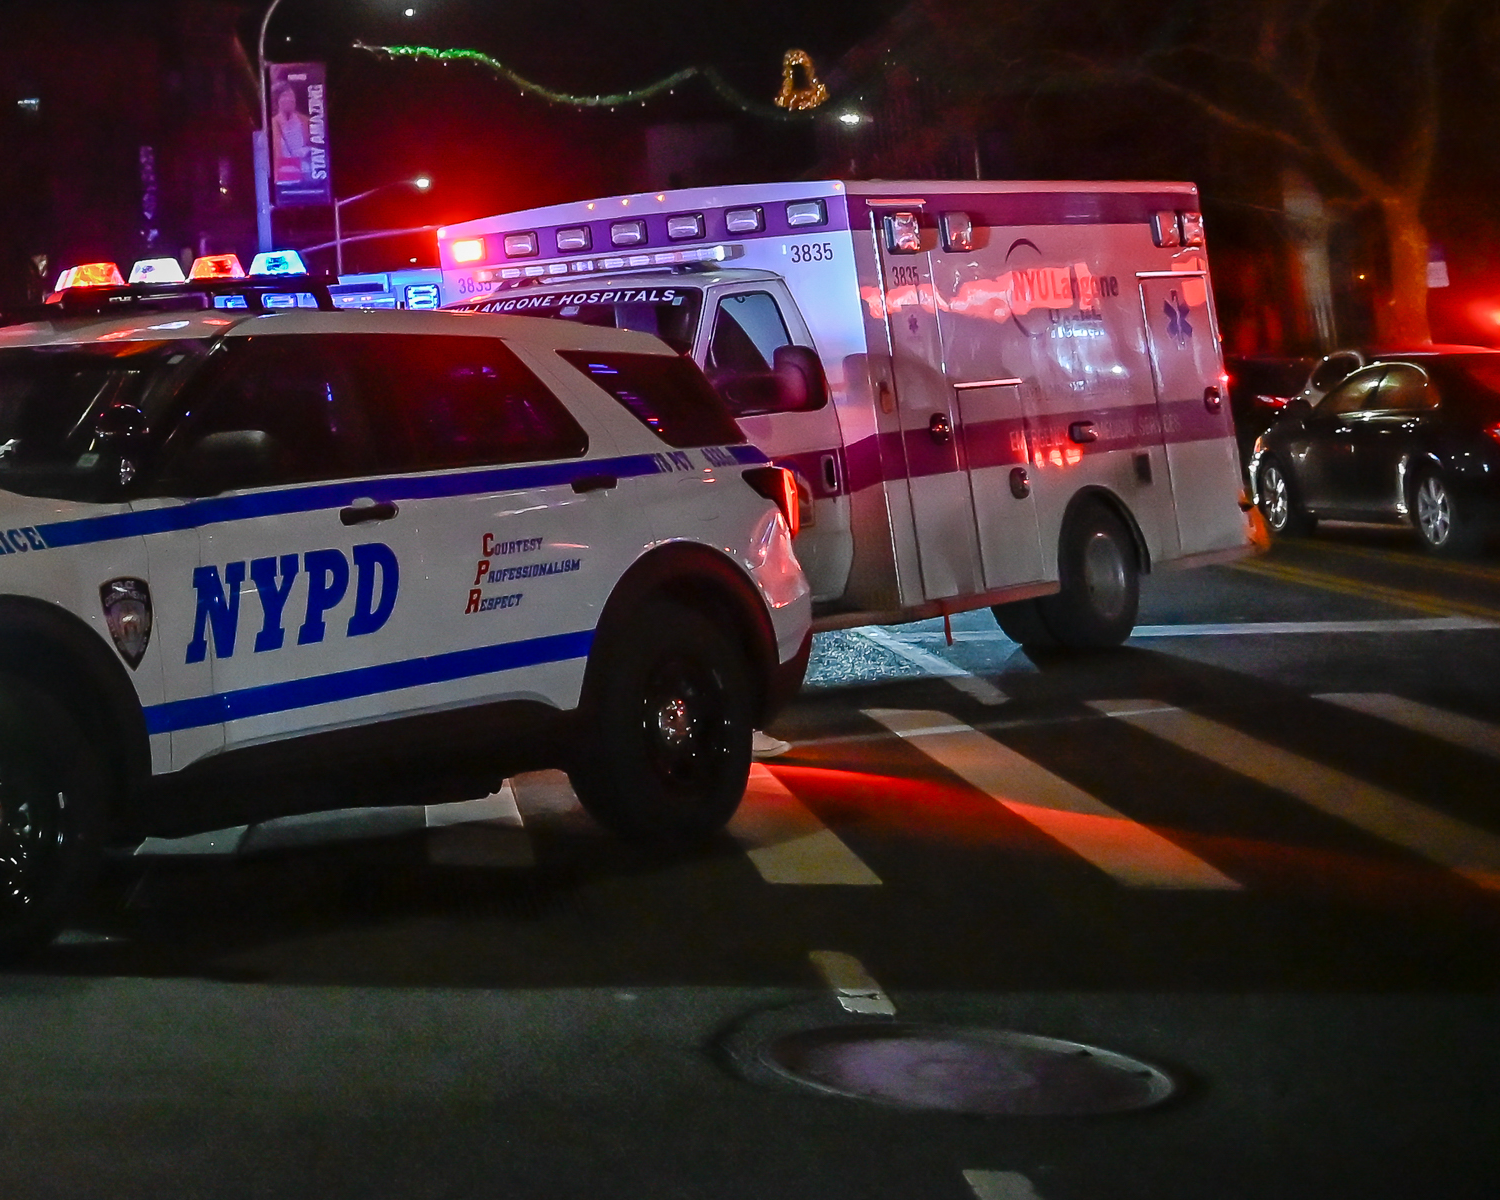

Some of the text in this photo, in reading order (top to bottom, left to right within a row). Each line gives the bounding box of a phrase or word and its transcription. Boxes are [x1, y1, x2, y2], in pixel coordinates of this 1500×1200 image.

[790, 242, 834, 264] 3835
[891, 266, 920, 287] 3835
[558, 289, 677, 306] HOSPITALS
[482, 532, 544, 558] COURTESY
[473, 559, 582, 586] PROFESSIONALISM
[185, 542, 401, 665] NYPD
[464, 588, 524, 615] RESPECT
